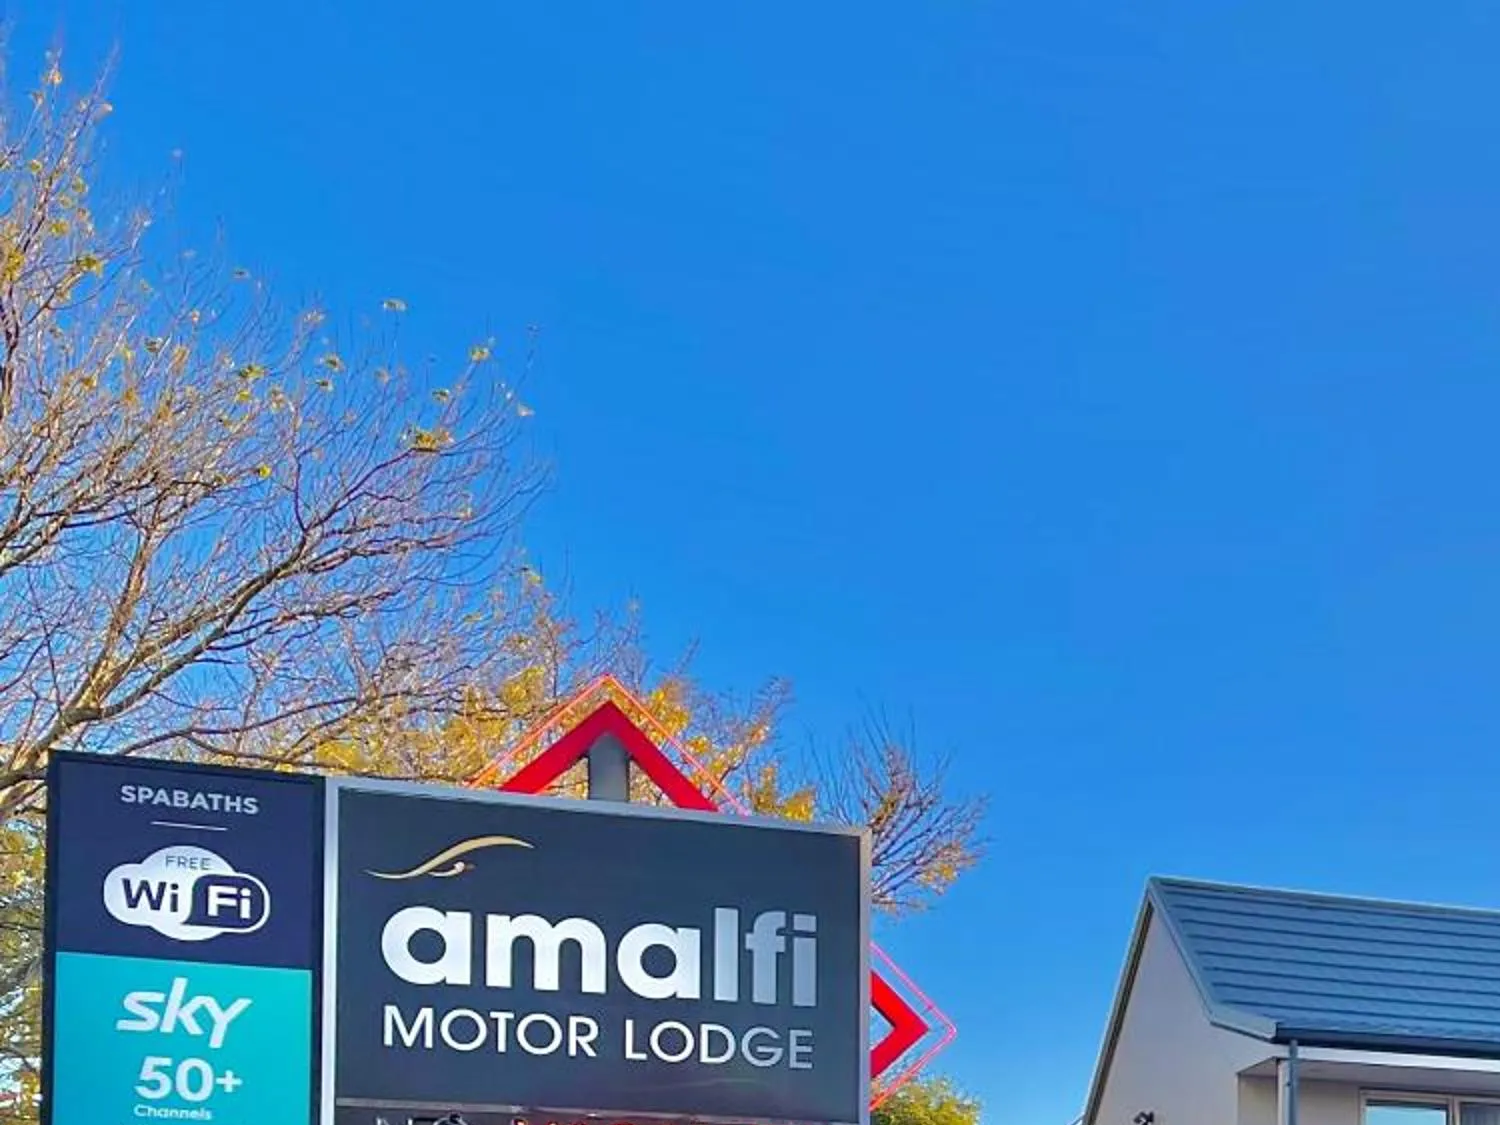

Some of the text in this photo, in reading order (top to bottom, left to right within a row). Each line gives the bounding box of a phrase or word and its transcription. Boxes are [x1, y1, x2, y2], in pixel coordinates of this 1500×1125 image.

[120, 784, 259, 815] SPABATHS
[165, 854, 212, 871] FREE
[381, 905, 817, 1007] amalfi
[115, 976, 253, 1049] sky
[383, 1004, 814, 1069] MOTOR LODGE
[133, 1055, 243, 1102] 50+
[133, 1104, 213, 1120] Channels
